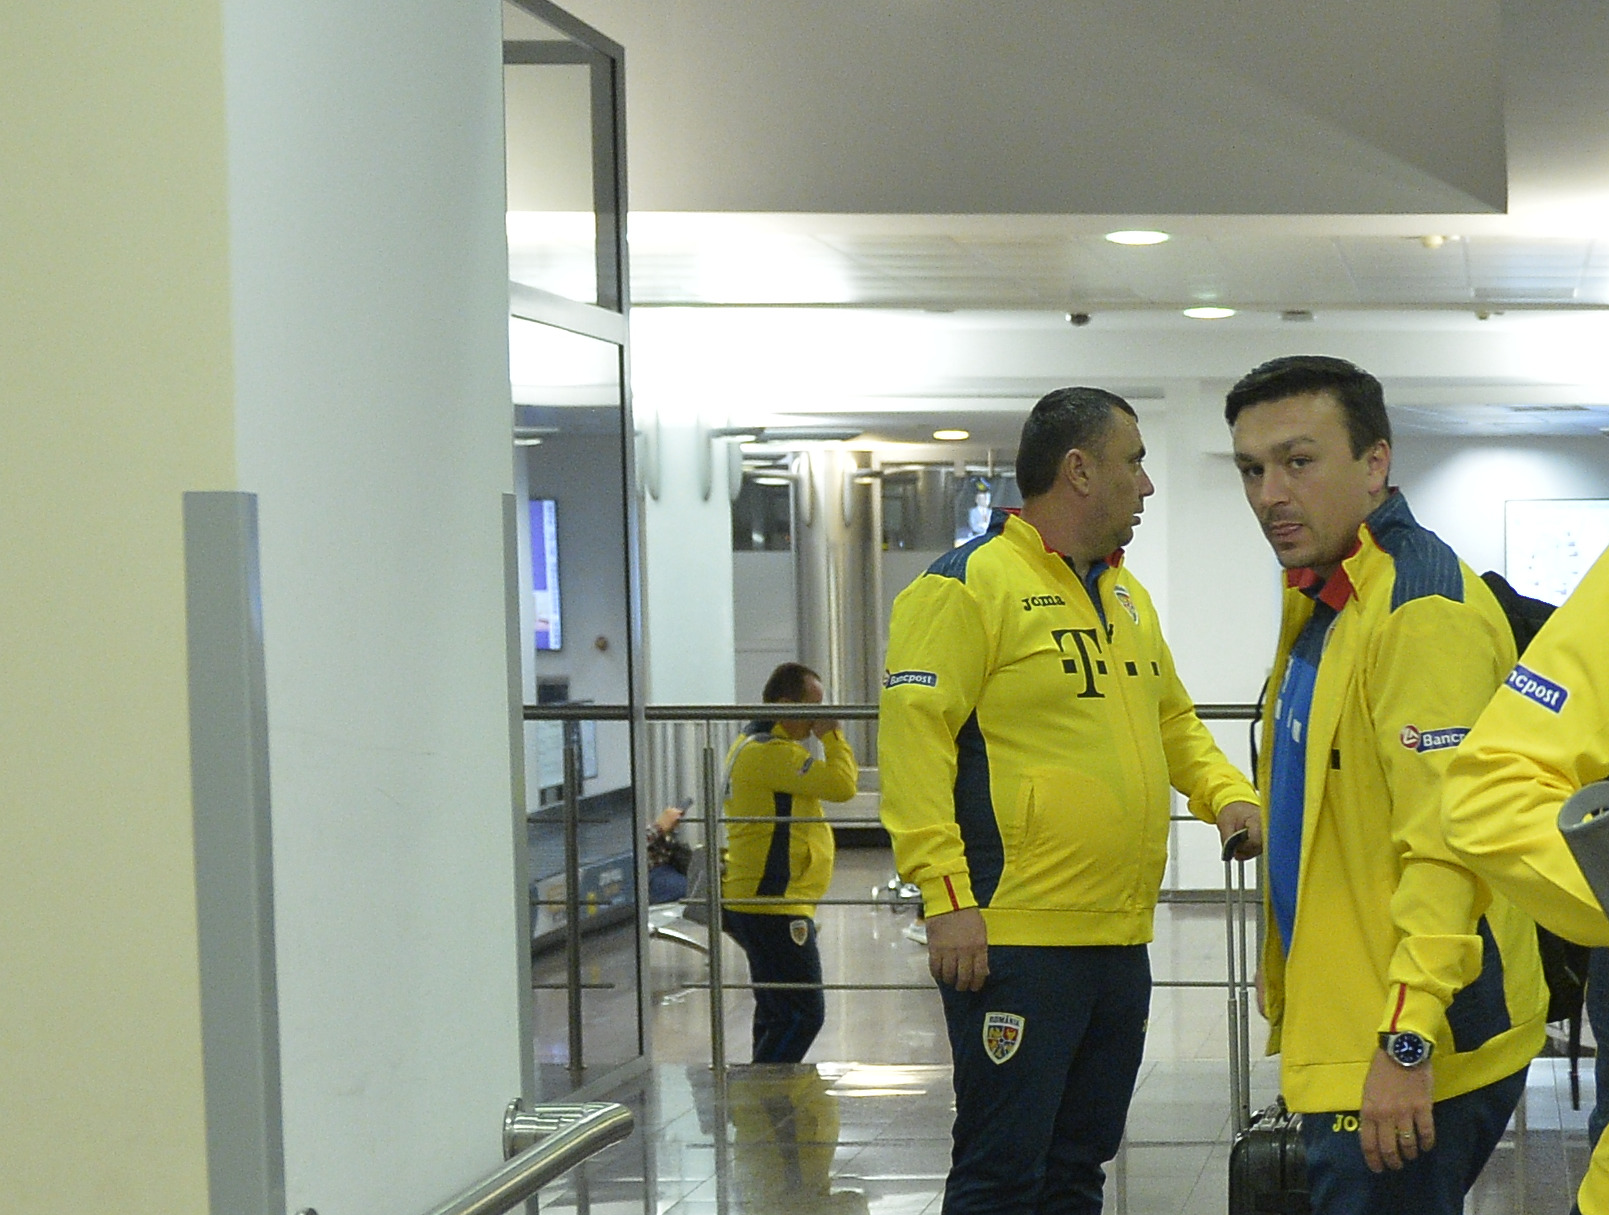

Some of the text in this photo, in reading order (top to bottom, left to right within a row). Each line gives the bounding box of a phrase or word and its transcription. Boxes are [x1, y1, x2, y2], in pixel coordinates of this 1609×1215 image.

[1021, 594, 1066, 612] Joma
[1051, 628, 1108, 698] T
[1509, 670, 1560, 706] ncpost
[1423, 733, 1465, 747] Banc
[1332, 1114, 1360, 1132] Jo
